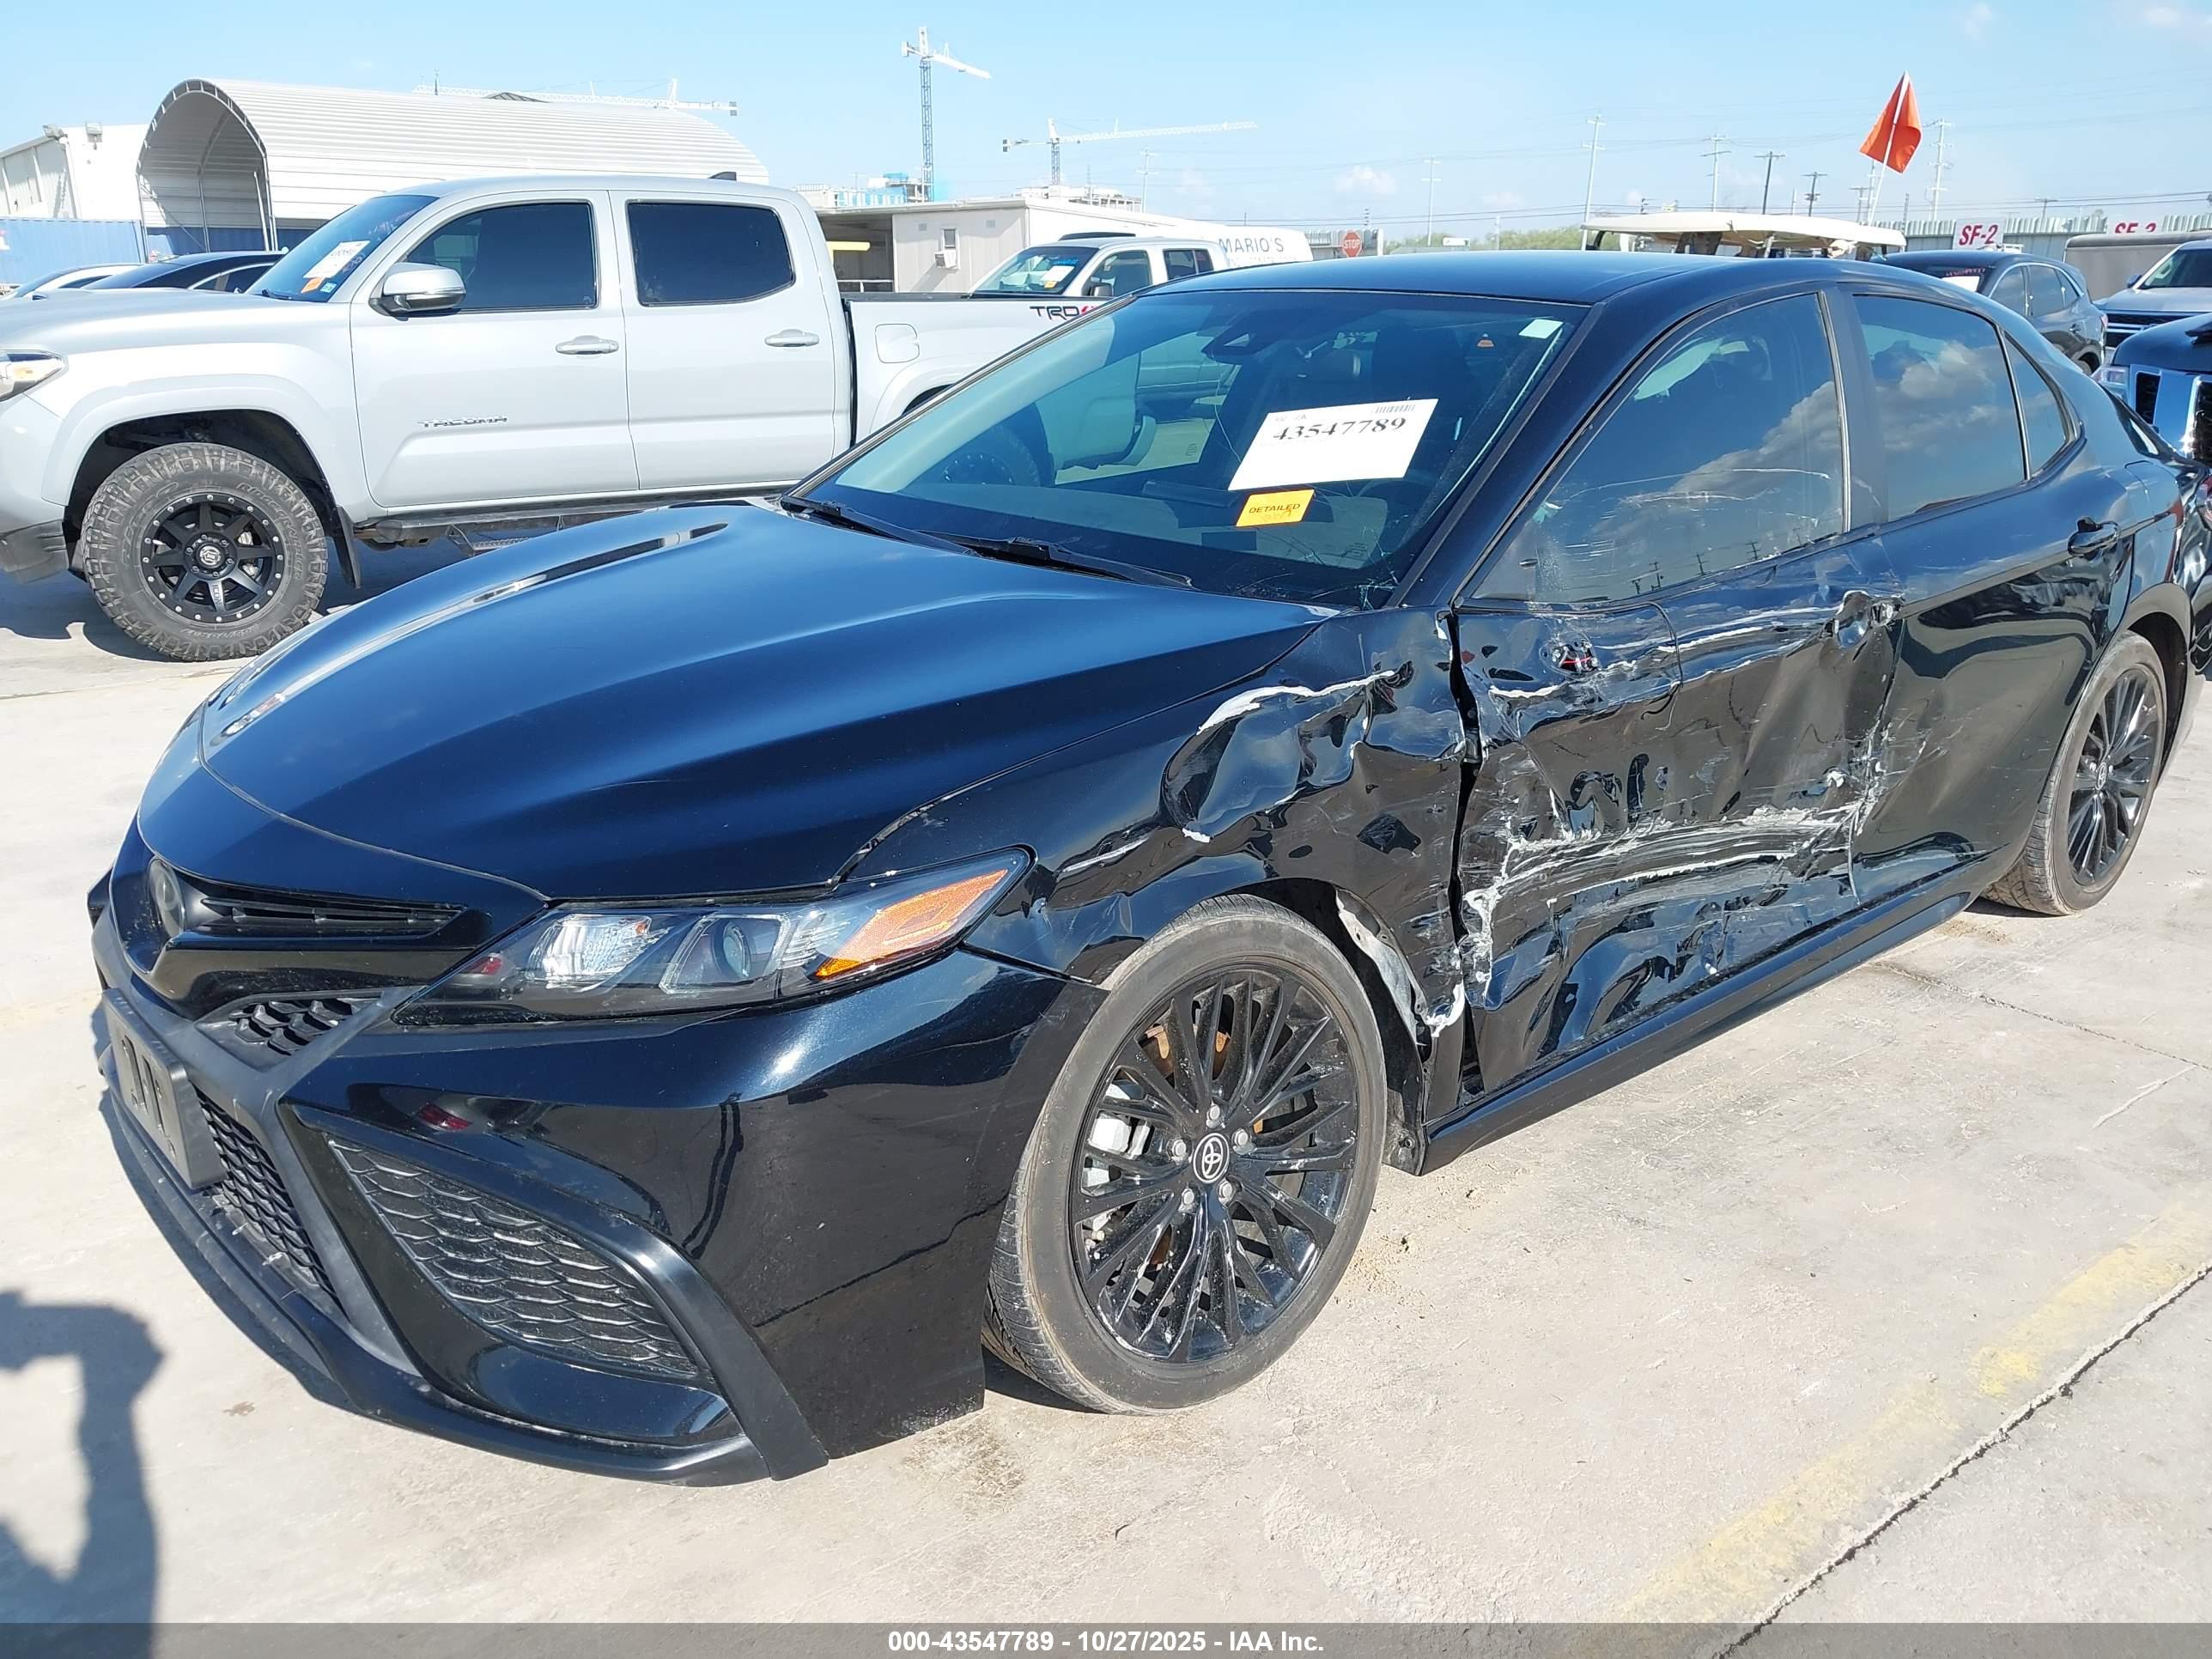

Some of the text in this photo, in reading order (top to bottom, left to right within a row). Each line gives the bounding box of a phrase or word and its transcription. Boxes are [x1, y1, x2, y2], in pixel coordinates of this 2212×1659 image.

[1959, 224, 1998, 246] SF-2
[1218, 237, 1284, 252] MARIO'S
[1343, 240, 1361, 249] STOP
[1030, 306, 1079, 320] TRD
[417, 413, 507, 428] TACOMA
[1273, 417, 1407, 440] 43547789
[1249, 503, 1301, 514] DETAILED
